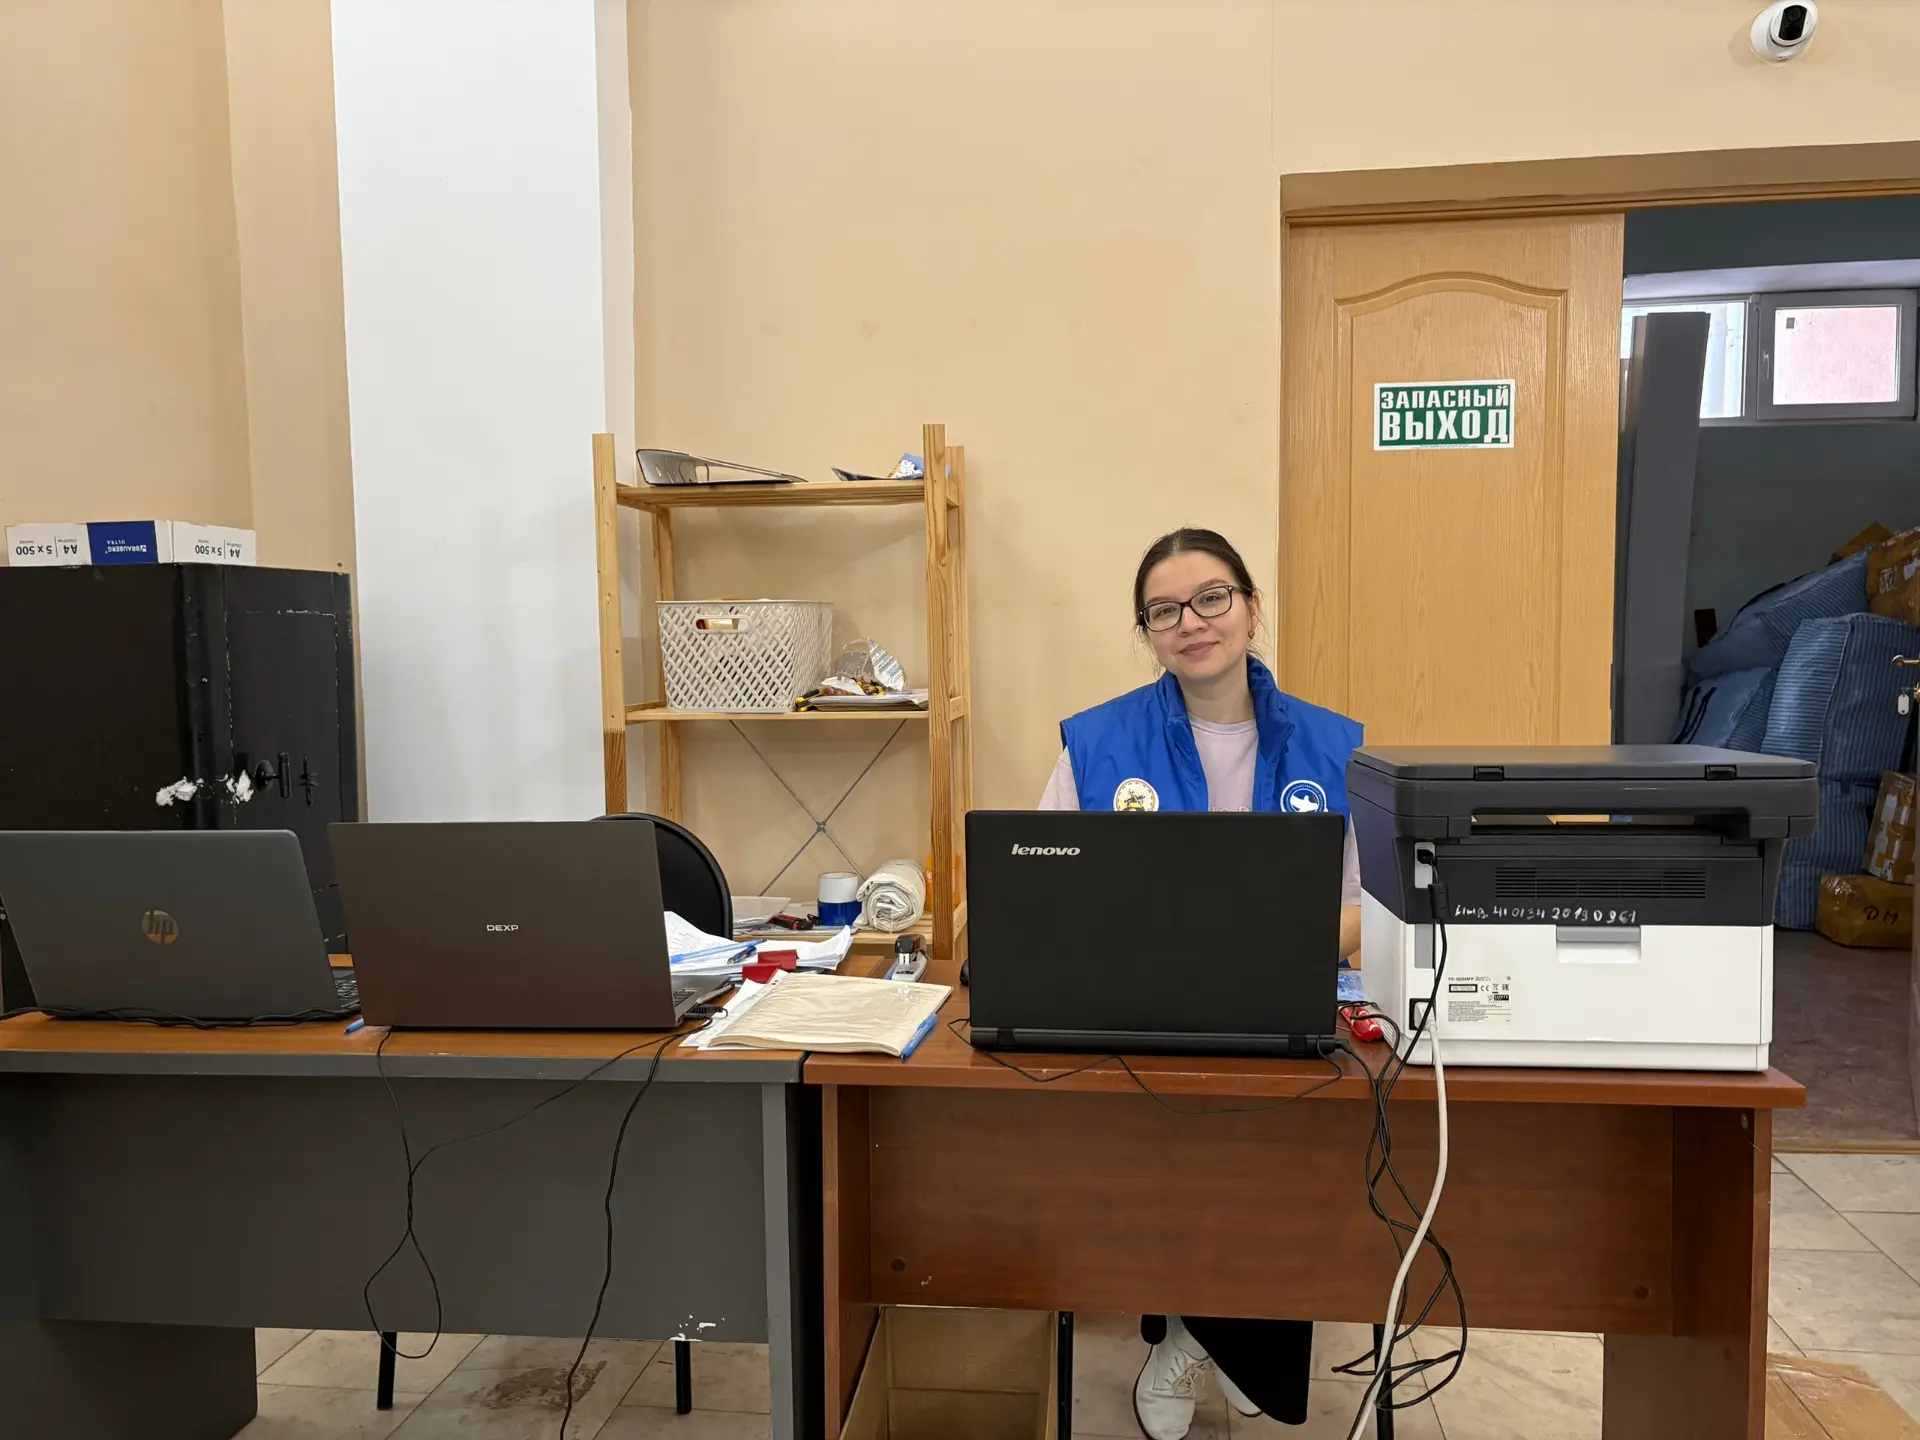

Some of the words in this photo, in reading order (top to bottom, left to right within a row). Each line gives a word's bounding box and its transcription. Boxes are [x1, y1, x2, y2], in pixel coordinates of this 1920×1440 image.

[1381, 385, 1509, 409] ЗАПАСНЫЙ
[1381, 409, 1509, 444] ВЫХОД
[16, 546, 35, 556] 500
[46, 545, 53, 555] 5
[63, 544, 78, 554] A4
[195, 545, 210, 555] 500
[217, 547, 223, 556] 5
[230, 548, 241, 558] A4
[1011, 843, 1081, 856] lenovo
[147, 910, 177, 945] hp
